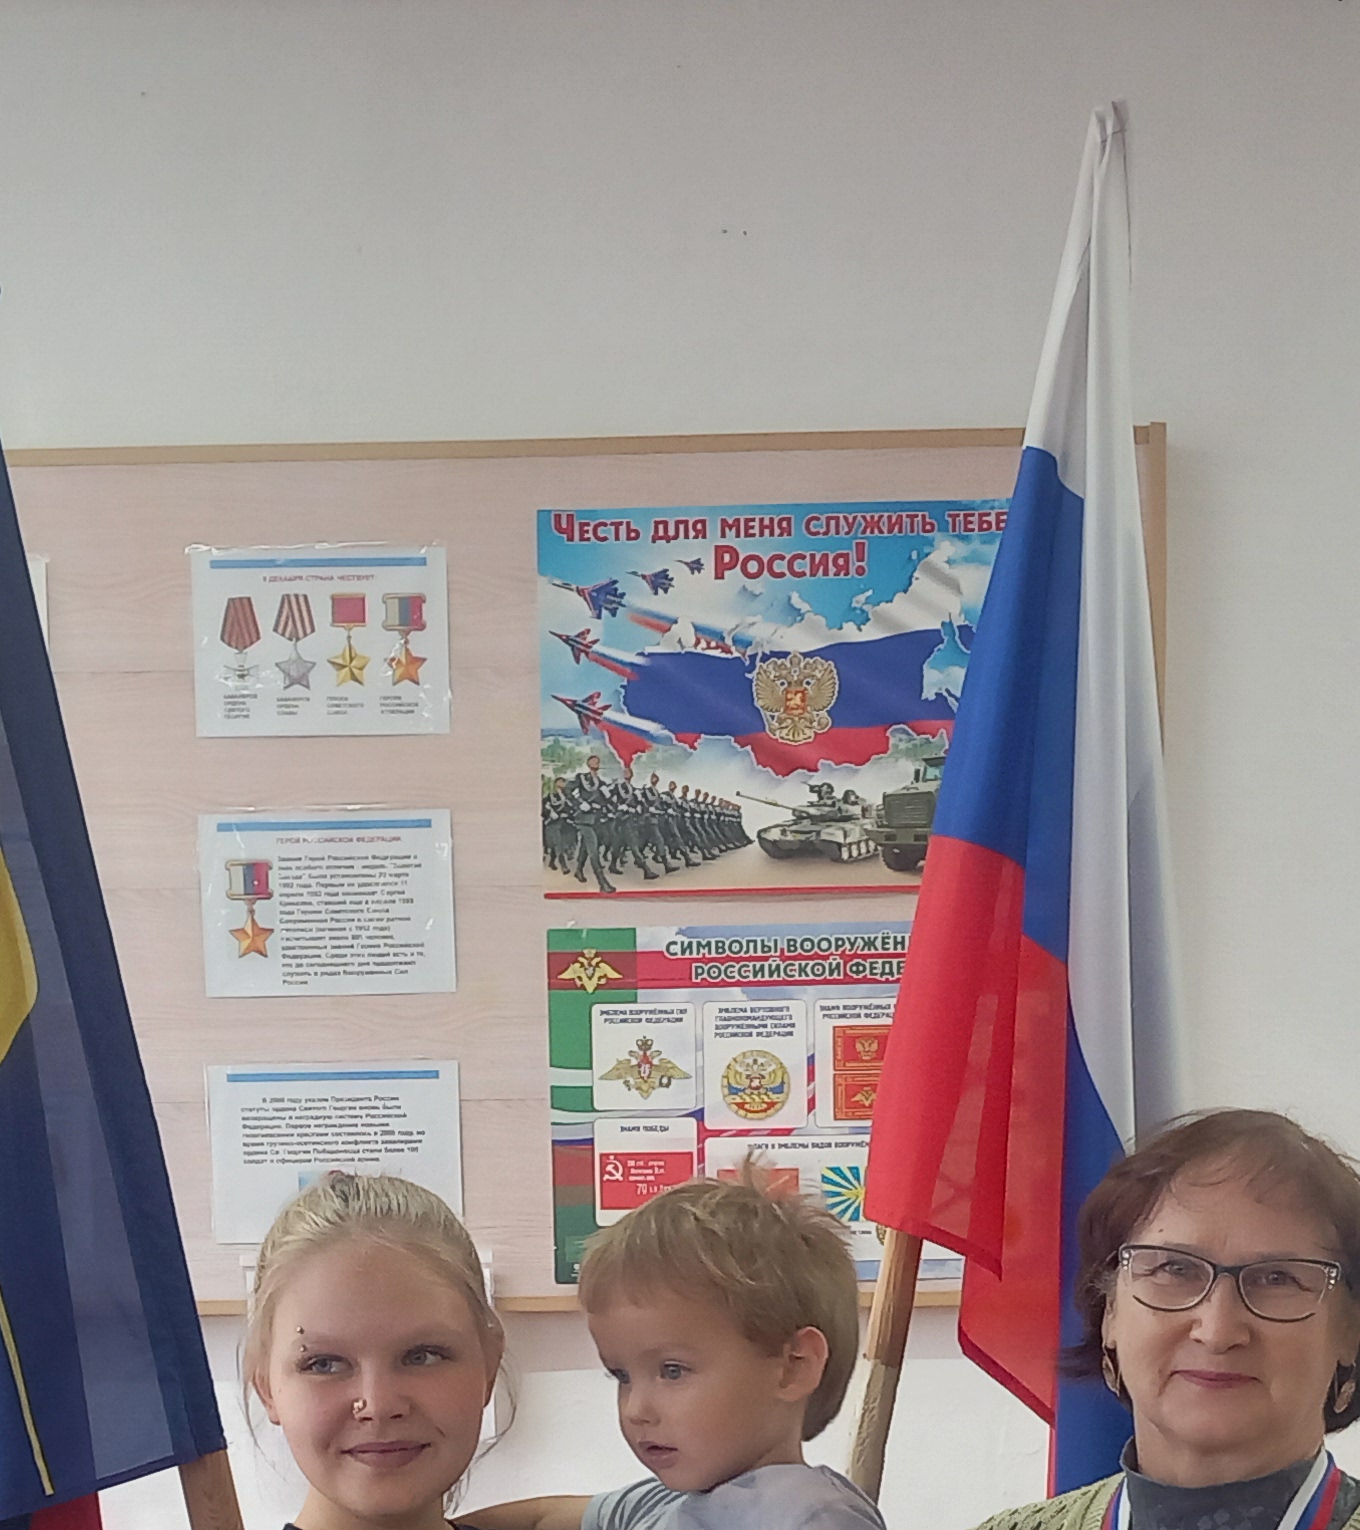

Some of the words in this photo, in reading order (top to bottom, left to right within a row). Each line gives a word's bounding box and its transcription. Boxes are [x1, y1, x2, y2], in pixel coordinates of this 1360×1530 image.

[553, 512, 641, 543] ЧЕСТЬ
[650, 517, 708, 544] ДЛЯ
[720, 514, 793, 539] МЕНЯ
[803, 511, 936, 538] СЛУЖИТЬ
[713, 540, 867, 581] РОССИЯ!
[666, 939, 779, 956] СИМВОЛЫ
[790, 931, 911, 953] ВООРУЖЁН
[694, 957, 842, 980] РОССИЙСКОЙ
